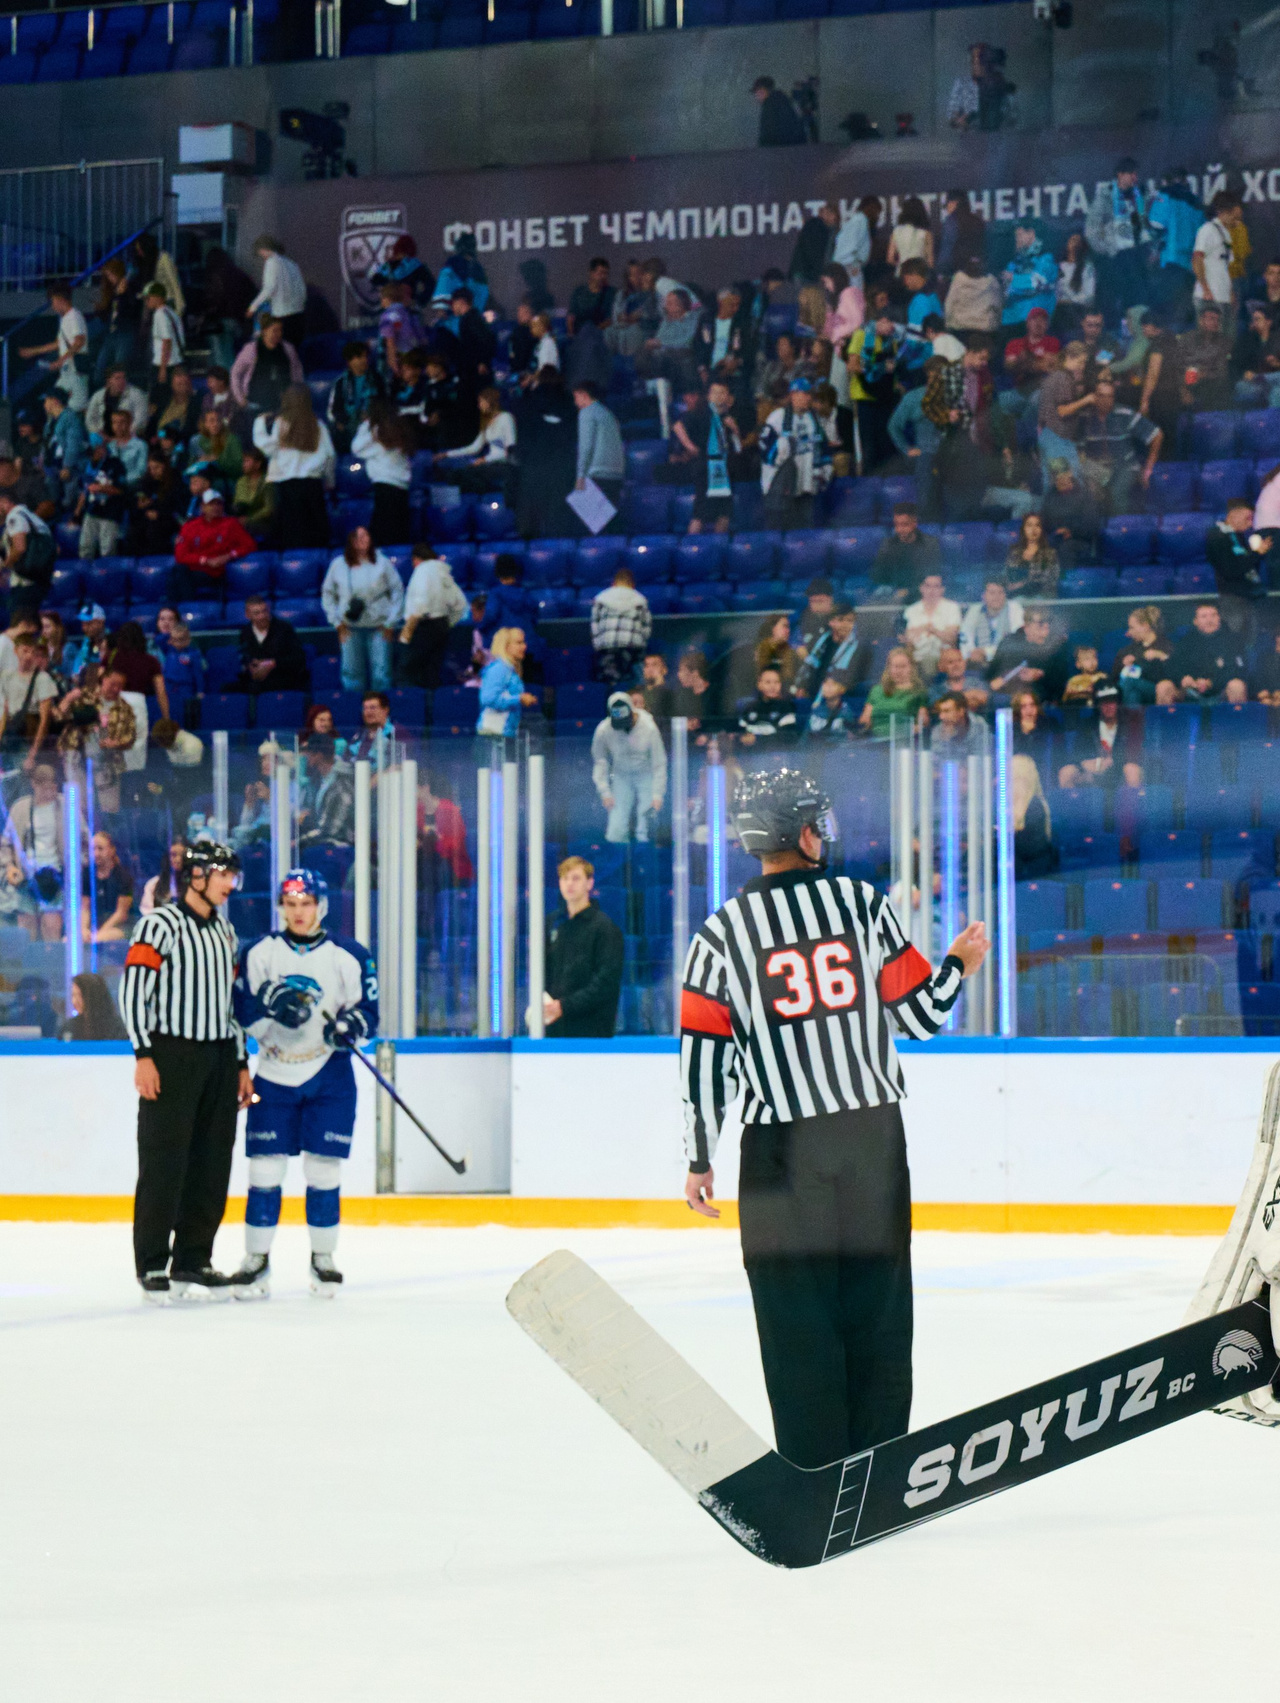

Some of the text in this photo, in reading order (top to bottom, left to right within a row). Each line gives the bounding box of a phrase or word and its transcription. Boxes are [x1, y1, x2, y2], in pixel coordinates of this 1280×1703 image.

[443, 214, 589, 253] ФОНБЕТ
[599, 200, 828, 245] ЧЕМПИОНАТ
[766, 940, 858, 1019] 36
[902, 1357, 1197, 1509] SOYUZ BC
